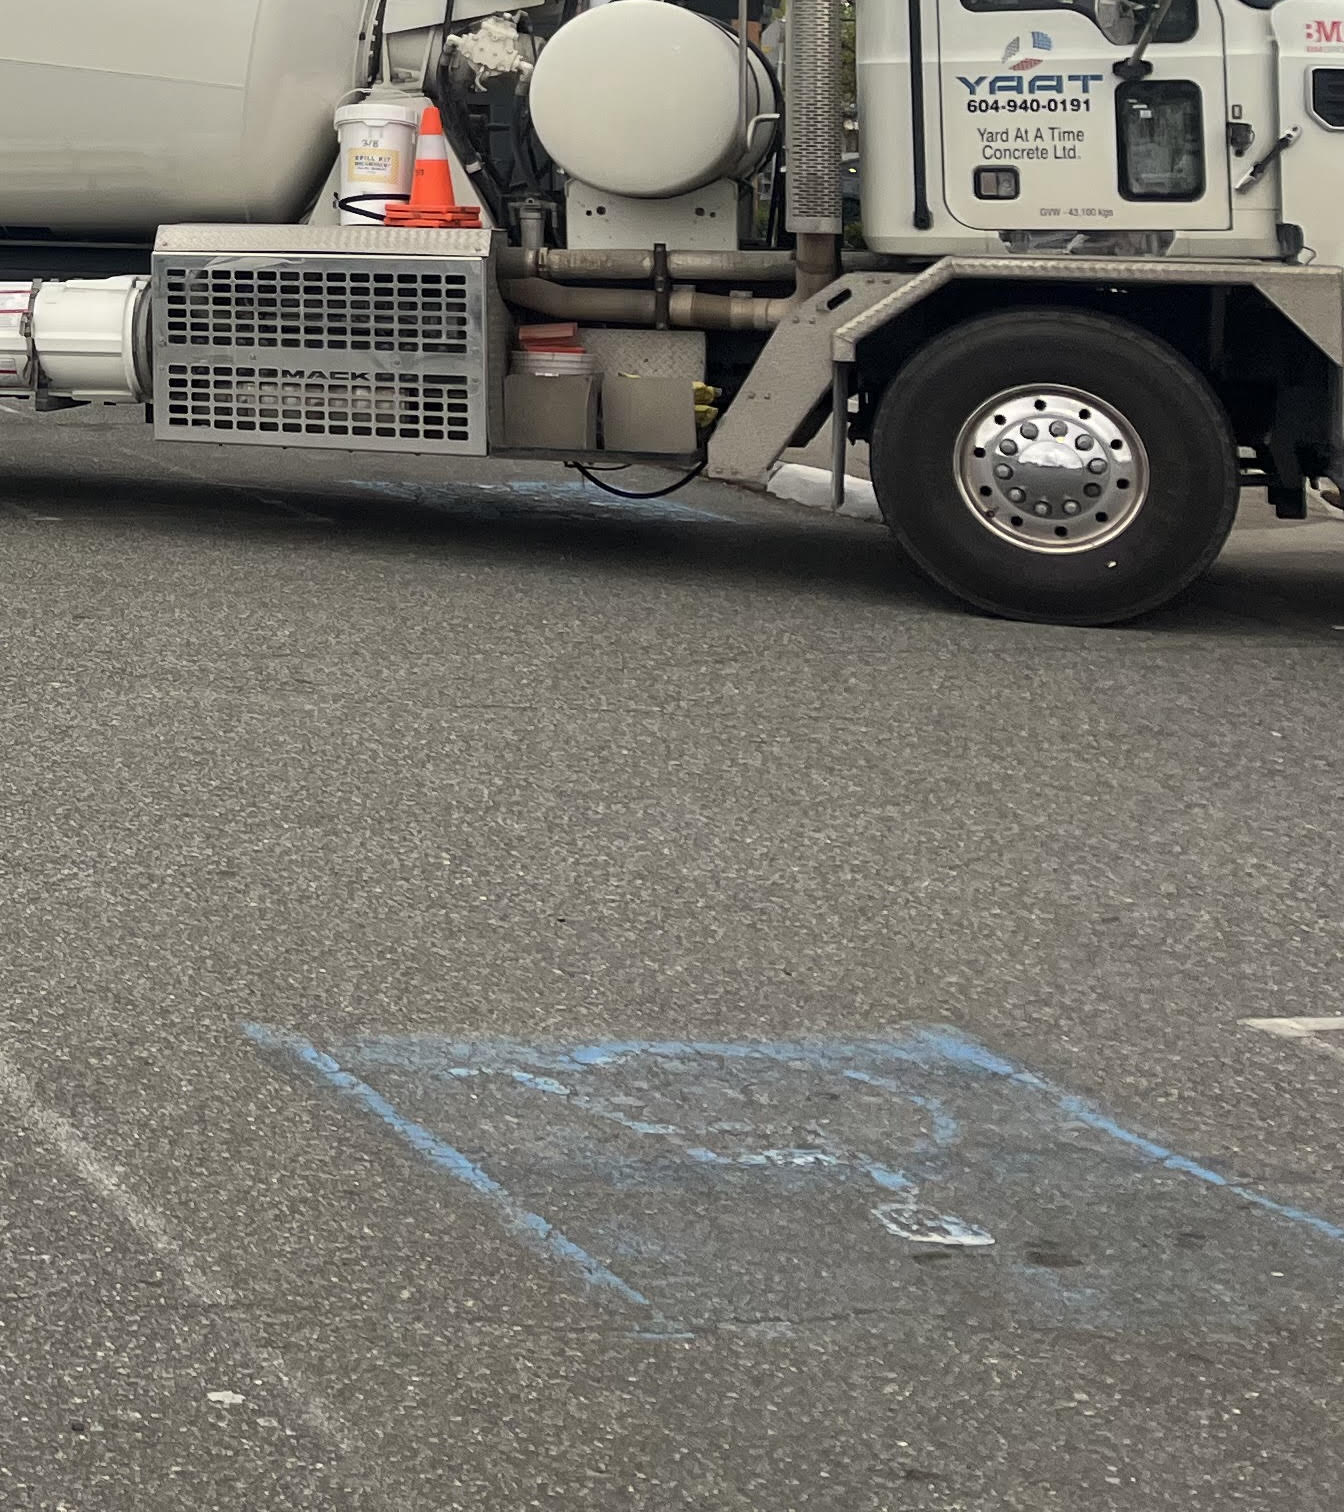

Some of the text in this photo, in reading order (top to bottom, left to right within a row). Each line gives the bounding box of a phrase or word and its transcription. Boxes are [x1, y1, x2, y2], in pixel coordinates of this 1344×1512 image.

[955, 75, 1104, 95] YAAT
[967, 98, 1091, 113] 604-940-0191
[977, 127, 1085, 143] Yard At A Time
[982, 145, 1082, 160] Concrete Ltd.
[282, 370, 370, 381] MACK
